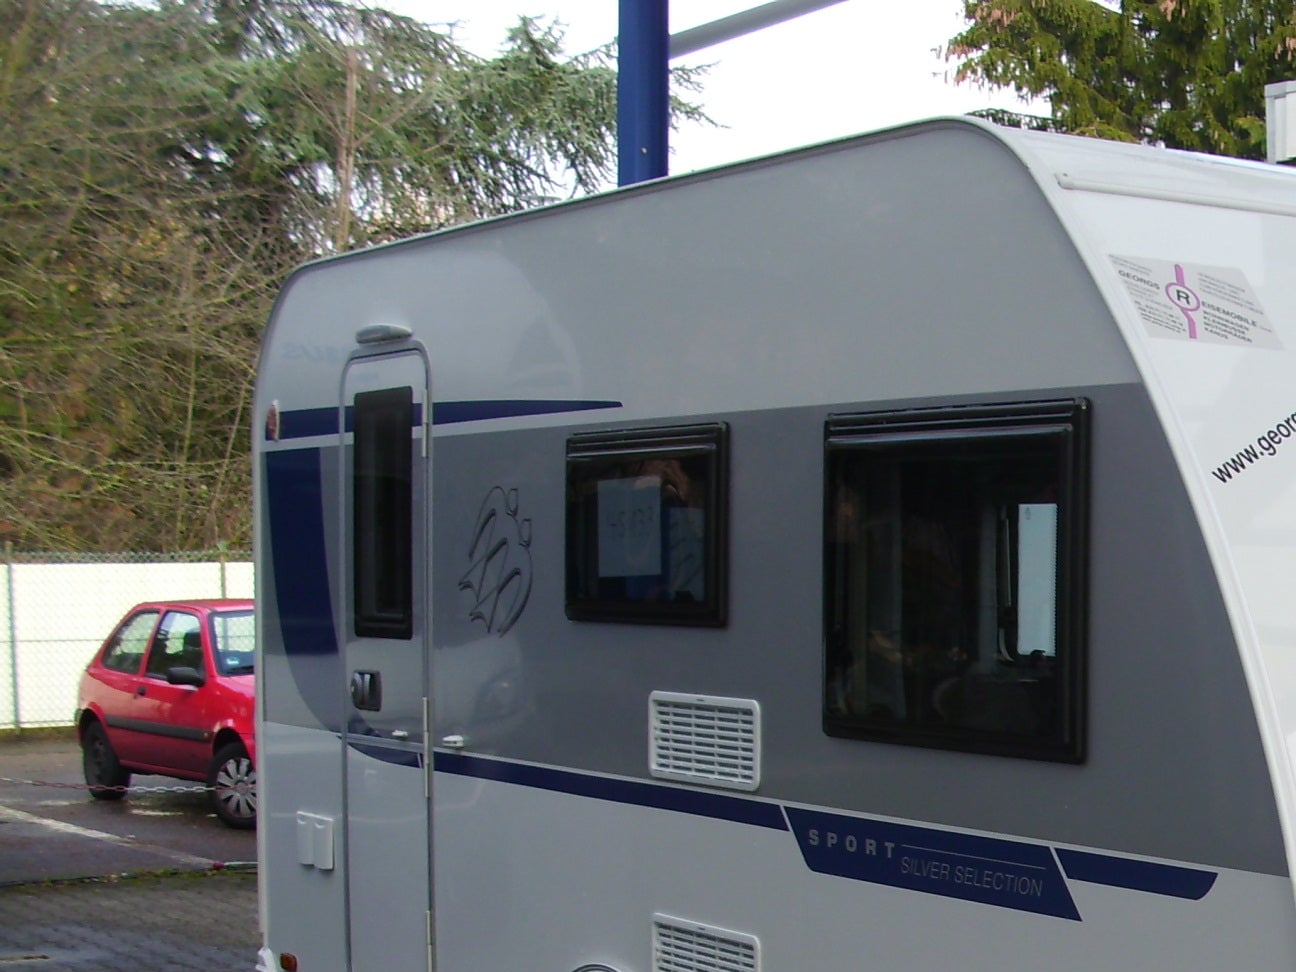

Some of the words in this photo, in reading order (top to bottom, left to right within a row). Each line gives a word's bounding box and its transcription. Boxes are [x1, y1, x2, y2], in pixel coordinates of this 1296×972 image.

[1118, 269, 1161, 290] GEORGS
[1175, 289, 1191, 306] R
[808, 829, 895, 859] SPORT
[900, 856, 951, 880] SILVER
[954, 866, 1043, 897] SELECTION
